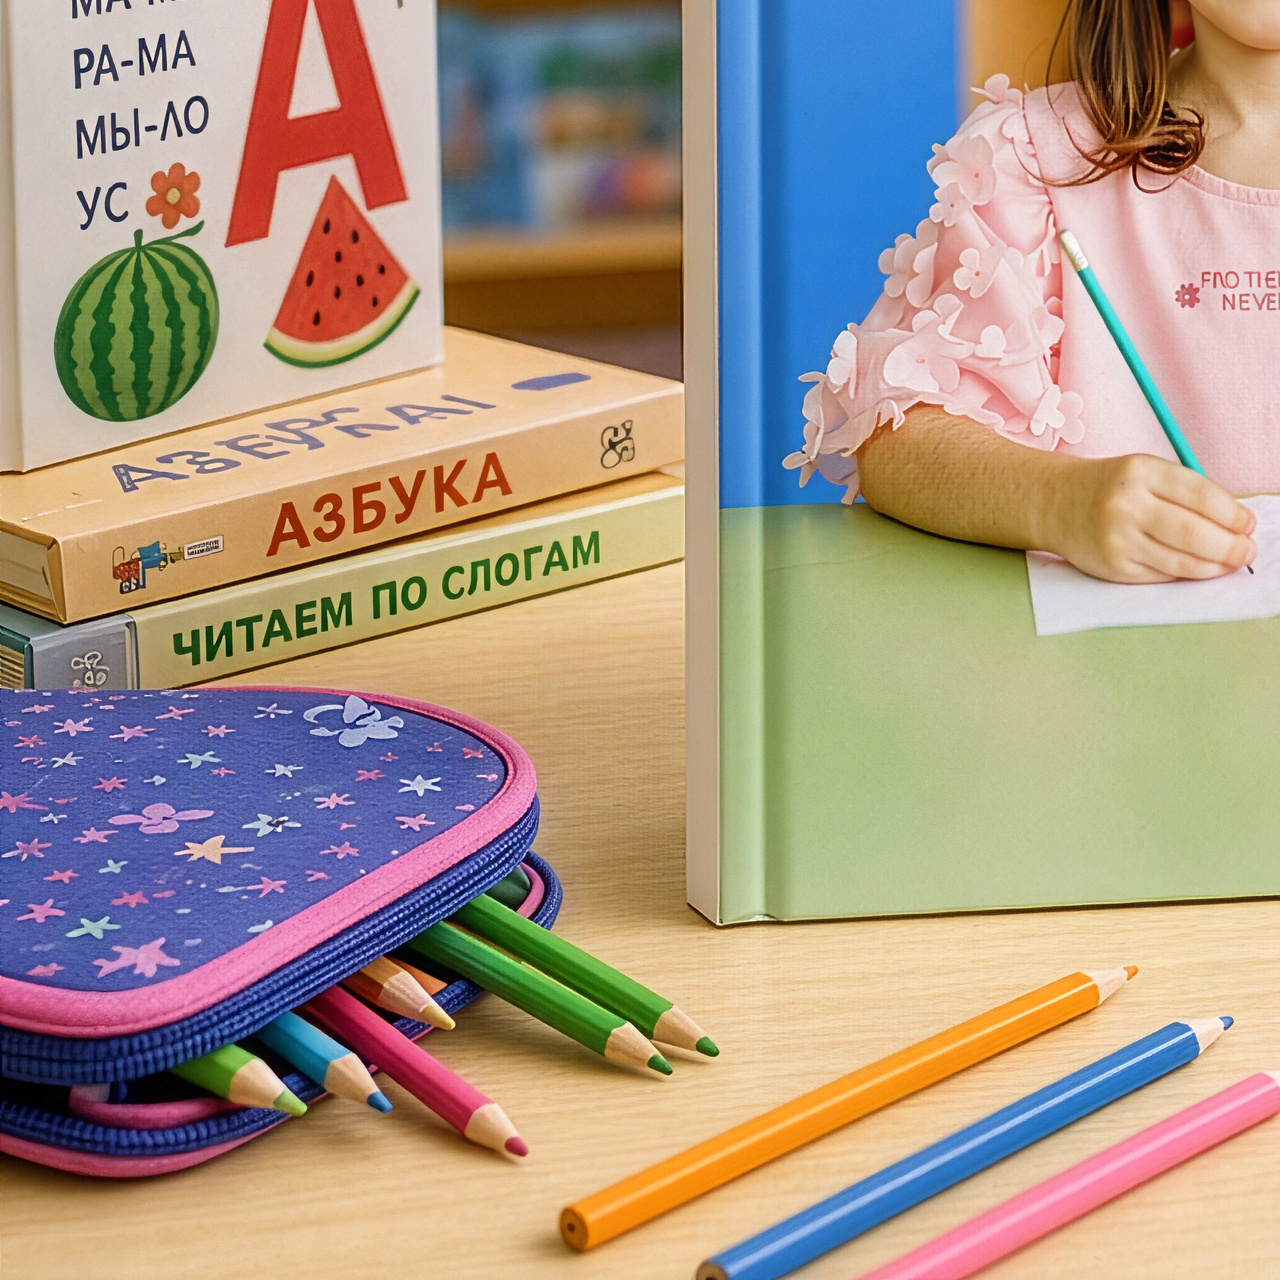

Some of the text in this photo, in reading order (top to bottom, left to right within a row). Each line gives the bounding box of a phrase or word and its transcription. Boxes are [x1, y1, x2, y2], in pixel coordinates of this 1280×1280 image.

[73, 29, 197, 89] РА-МА
[76, 95, 210, 160] МЫ-ЛО
[76, 181, 129, 231] УС
[265, 451, 513, 557] АЗБУКА
[172, 530, 602, 666] ЧИТАЕМ ПО СЛОГАМ
